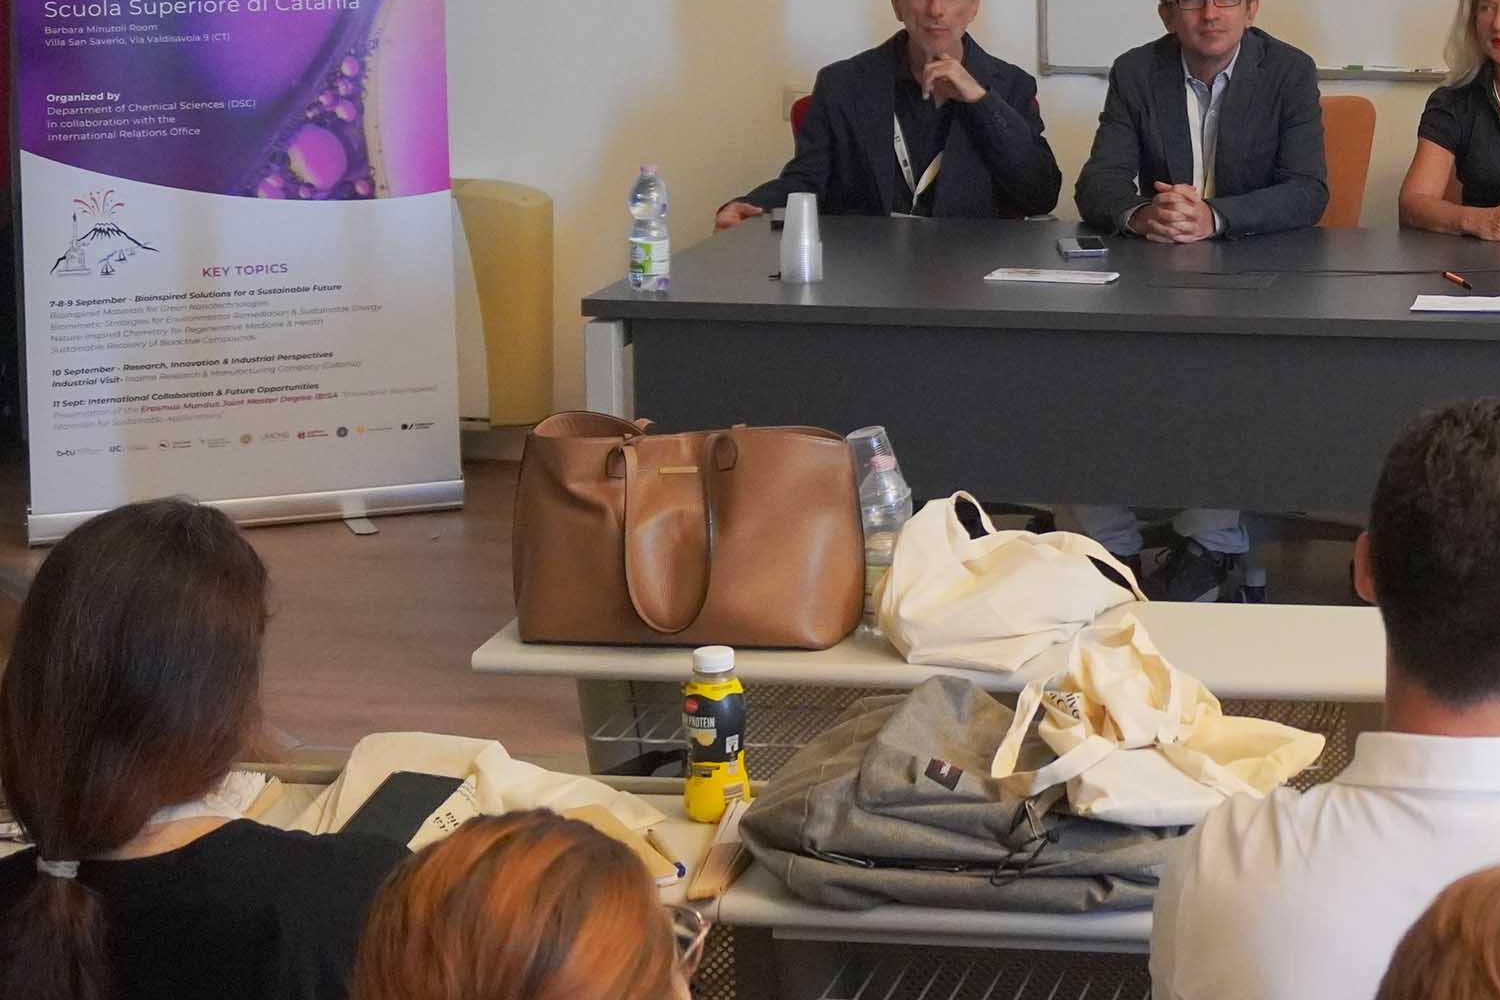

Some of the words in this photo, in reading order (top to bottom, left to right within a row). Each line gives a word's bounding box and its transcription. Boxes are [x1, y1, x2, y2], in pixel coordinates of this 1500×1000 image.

[44, 25, 83, 34] Barbara
[86, 23, 126, 33] Minutoli
[129, 23, 158, 32] Room
[46, 91, 103, 104] Organized
[106, 91, 120, 102] by
[47, 104, 112, 116] Department
[114, 103, 125, 112] of
[127, 101, 176, 112] Chemical
[179, 100, 224, 110] Sciences
[227, 99, 256, 109] (DSC)
[59, 117, 129, 128] collaboration
[132, 115, 155, 124] with
[157, 115, 175, 124] the
[47, 130, 116, 142] International
[119, 128, 167, 138] Relations
[169, 126, 200, 136] Office
[202, 266, 230, 277] KEY
[234, 262, 288, 276] TOPICS
[75, 296, 126, 307] September
[189, 289, 231, 299] Solutions
[256, 284, 310, 295] Sustainable
[312, 282, 342, 292] Future
[63, 365, 115, 376] September
[122, 361, 168, 371] Research,
[170, 358, 220, 368] Innovation
[231, 355, 275, 364] Industrial
[276, 350, 333, 362] Perspectives
